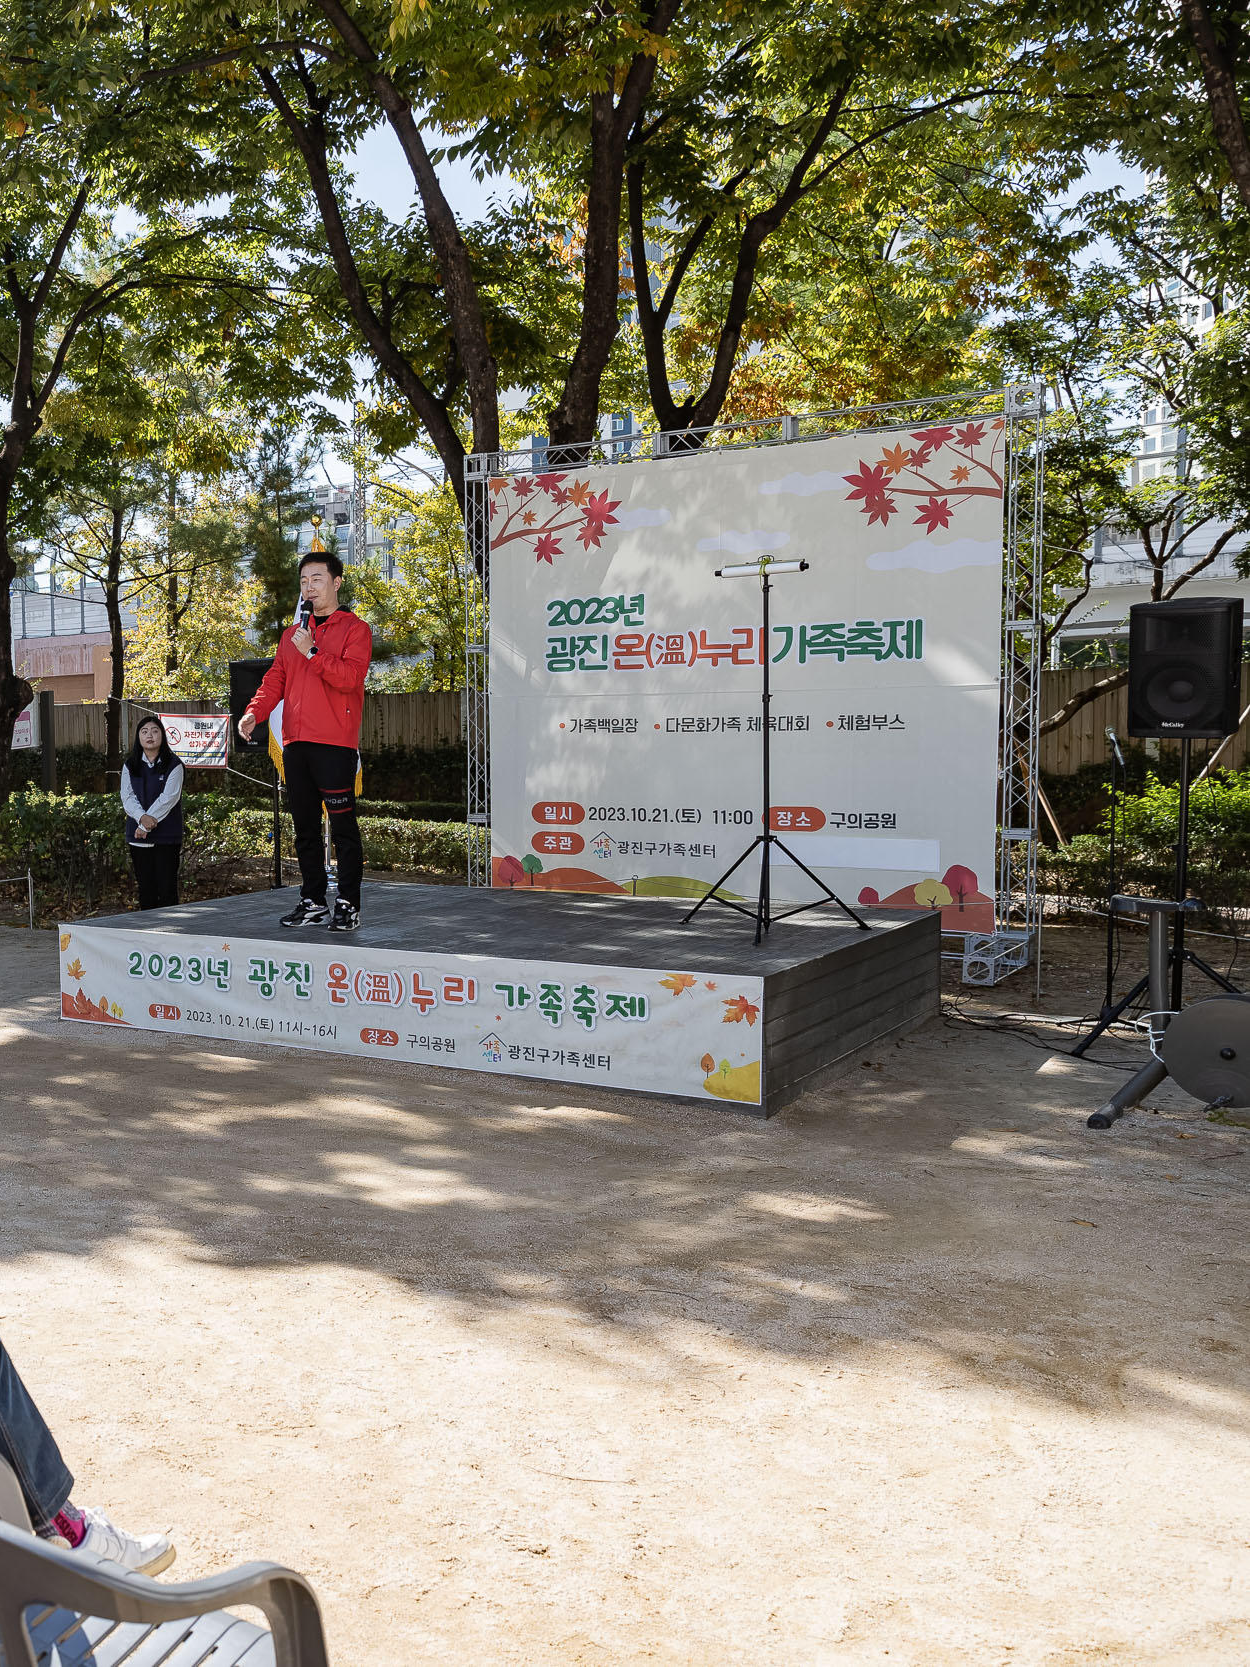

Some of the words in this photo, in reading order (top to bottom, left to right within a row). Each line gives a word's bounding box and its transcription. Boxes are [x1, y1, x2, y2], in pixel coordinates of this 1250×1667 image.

[546, 593, 645, 627] 2023년
[545, 634, 609, 673] 광진
[771, 618, 923, 664] 가족축제
[569, 717, 639, 734] 가족백일장
[665, 716, 742, 733] 다문화가족
[746, 715, 810, 732] 체육대회
[837, 713, 906, 731] 체험부스
[543, 805, 573, 821] 일시
[588, 806, 702, 824] 2023.10.21.(토)
[712, 809, 753, 825] 11:00
[776, 810, 812, 828] 장소
[829, 812, 897, 830] 구의공원
[543, 835, 573, 851] 주관
[616, 841, 717, 858] 광진구가족센터
[128, 951, 229, 989] 2023년
[248, 958, 311, 997] 광진
[327, 962, 475, 1013] 온(溫)누리
[494, 983, 646, 1028] 가족축제
[278, 1020, 338, 1040] 11시~16시
[406, 1033, 456, 1053] 구의공원
[507, 1044, 612, 1071] 광진구가족센터
